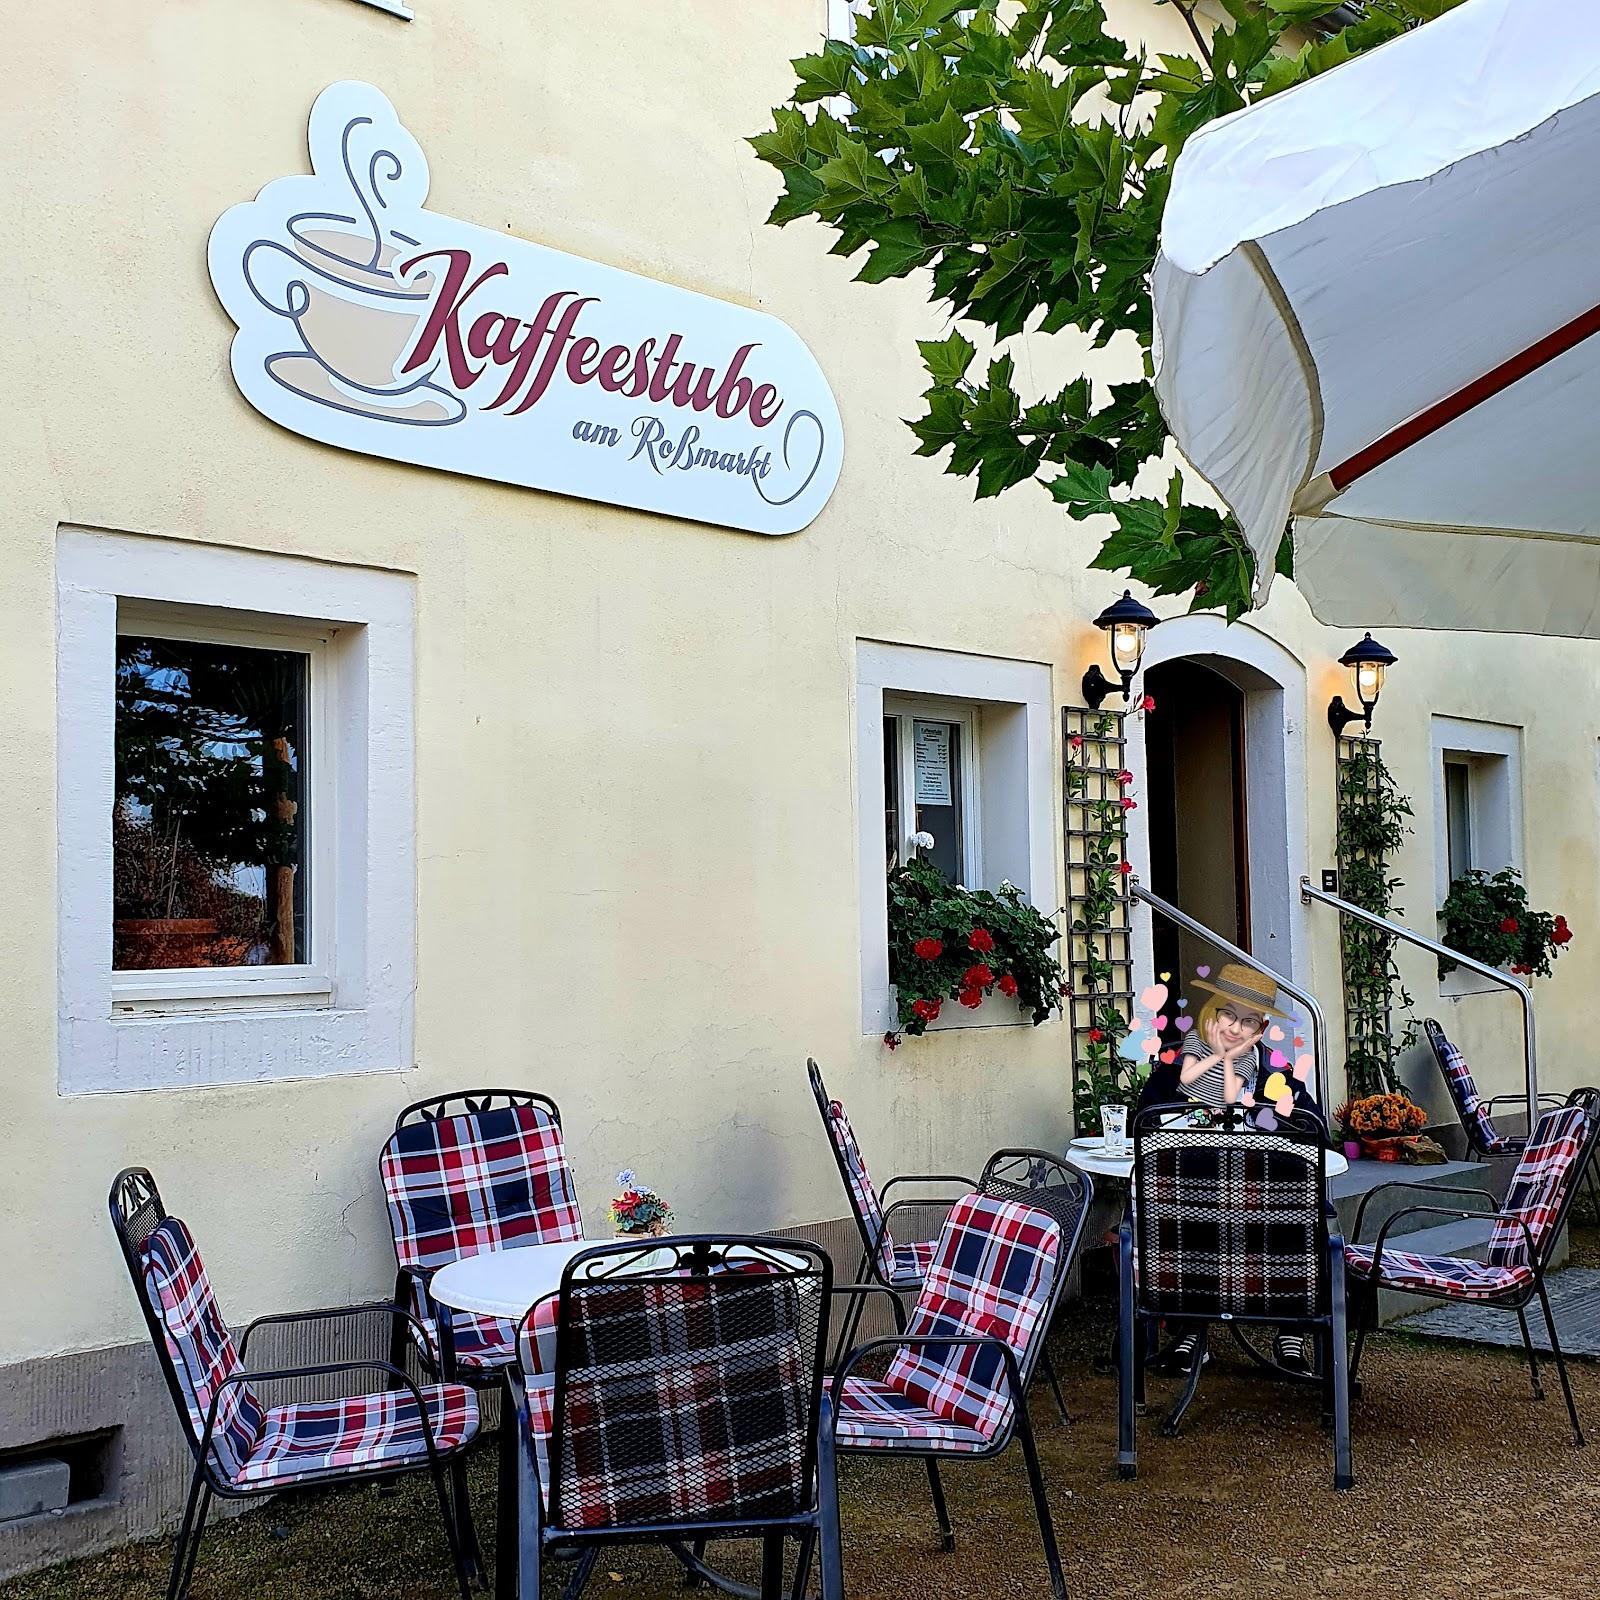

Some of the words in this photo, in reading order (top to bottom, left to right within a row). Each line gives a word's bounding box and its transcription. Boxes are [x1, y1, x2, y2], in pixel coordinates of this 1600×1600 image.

[399, 249, 783, 428] Kaffeestube
[572, 420, 622, 447] am
[627, 416, 772, 497] Roßmarkt
